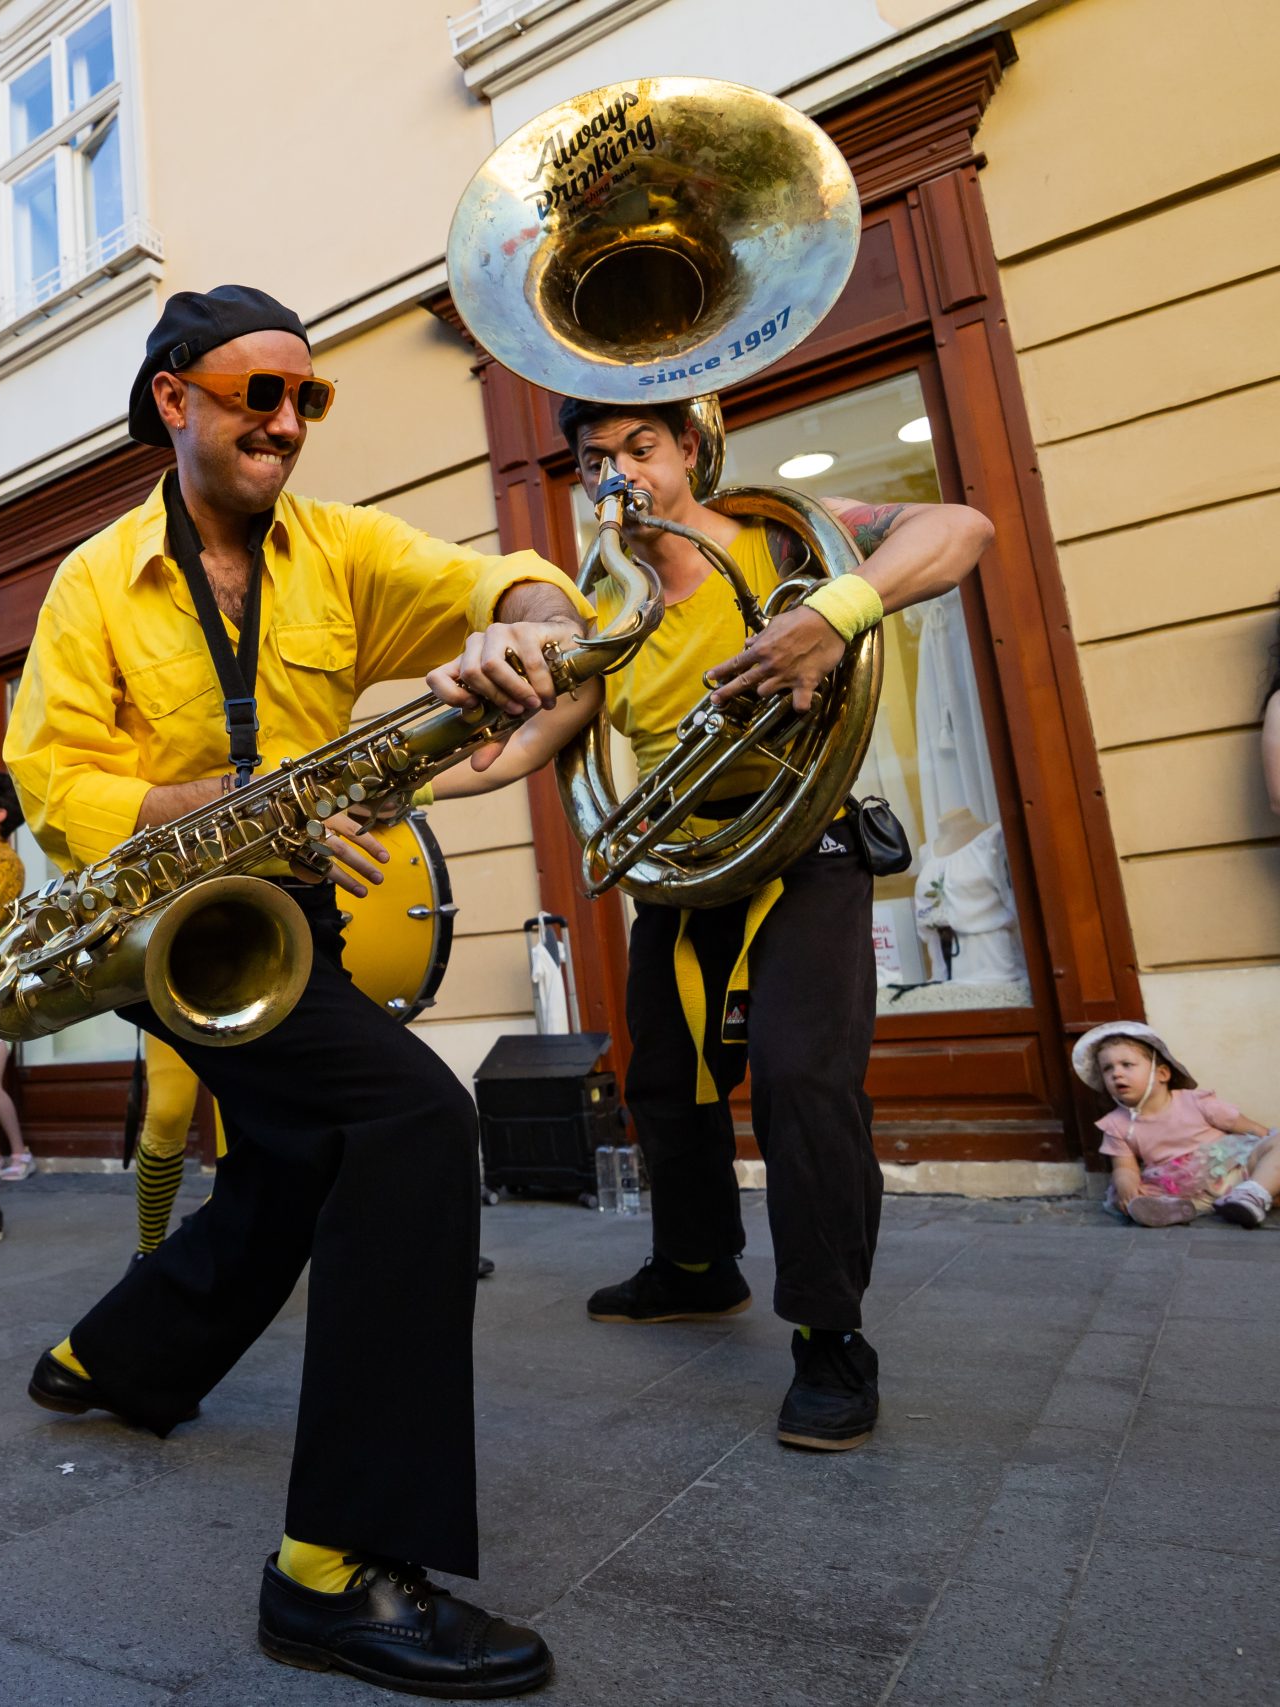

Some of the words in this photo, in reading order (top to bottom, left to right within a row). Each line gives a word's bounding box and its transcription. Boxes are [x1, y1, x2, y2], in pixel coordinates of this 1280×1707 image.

[523, 114, 656, 221] Drinking
[528, 91, 639, 183] Always
[638, 356, 721, 386] since
[727, 305, 792, 361] 1997
